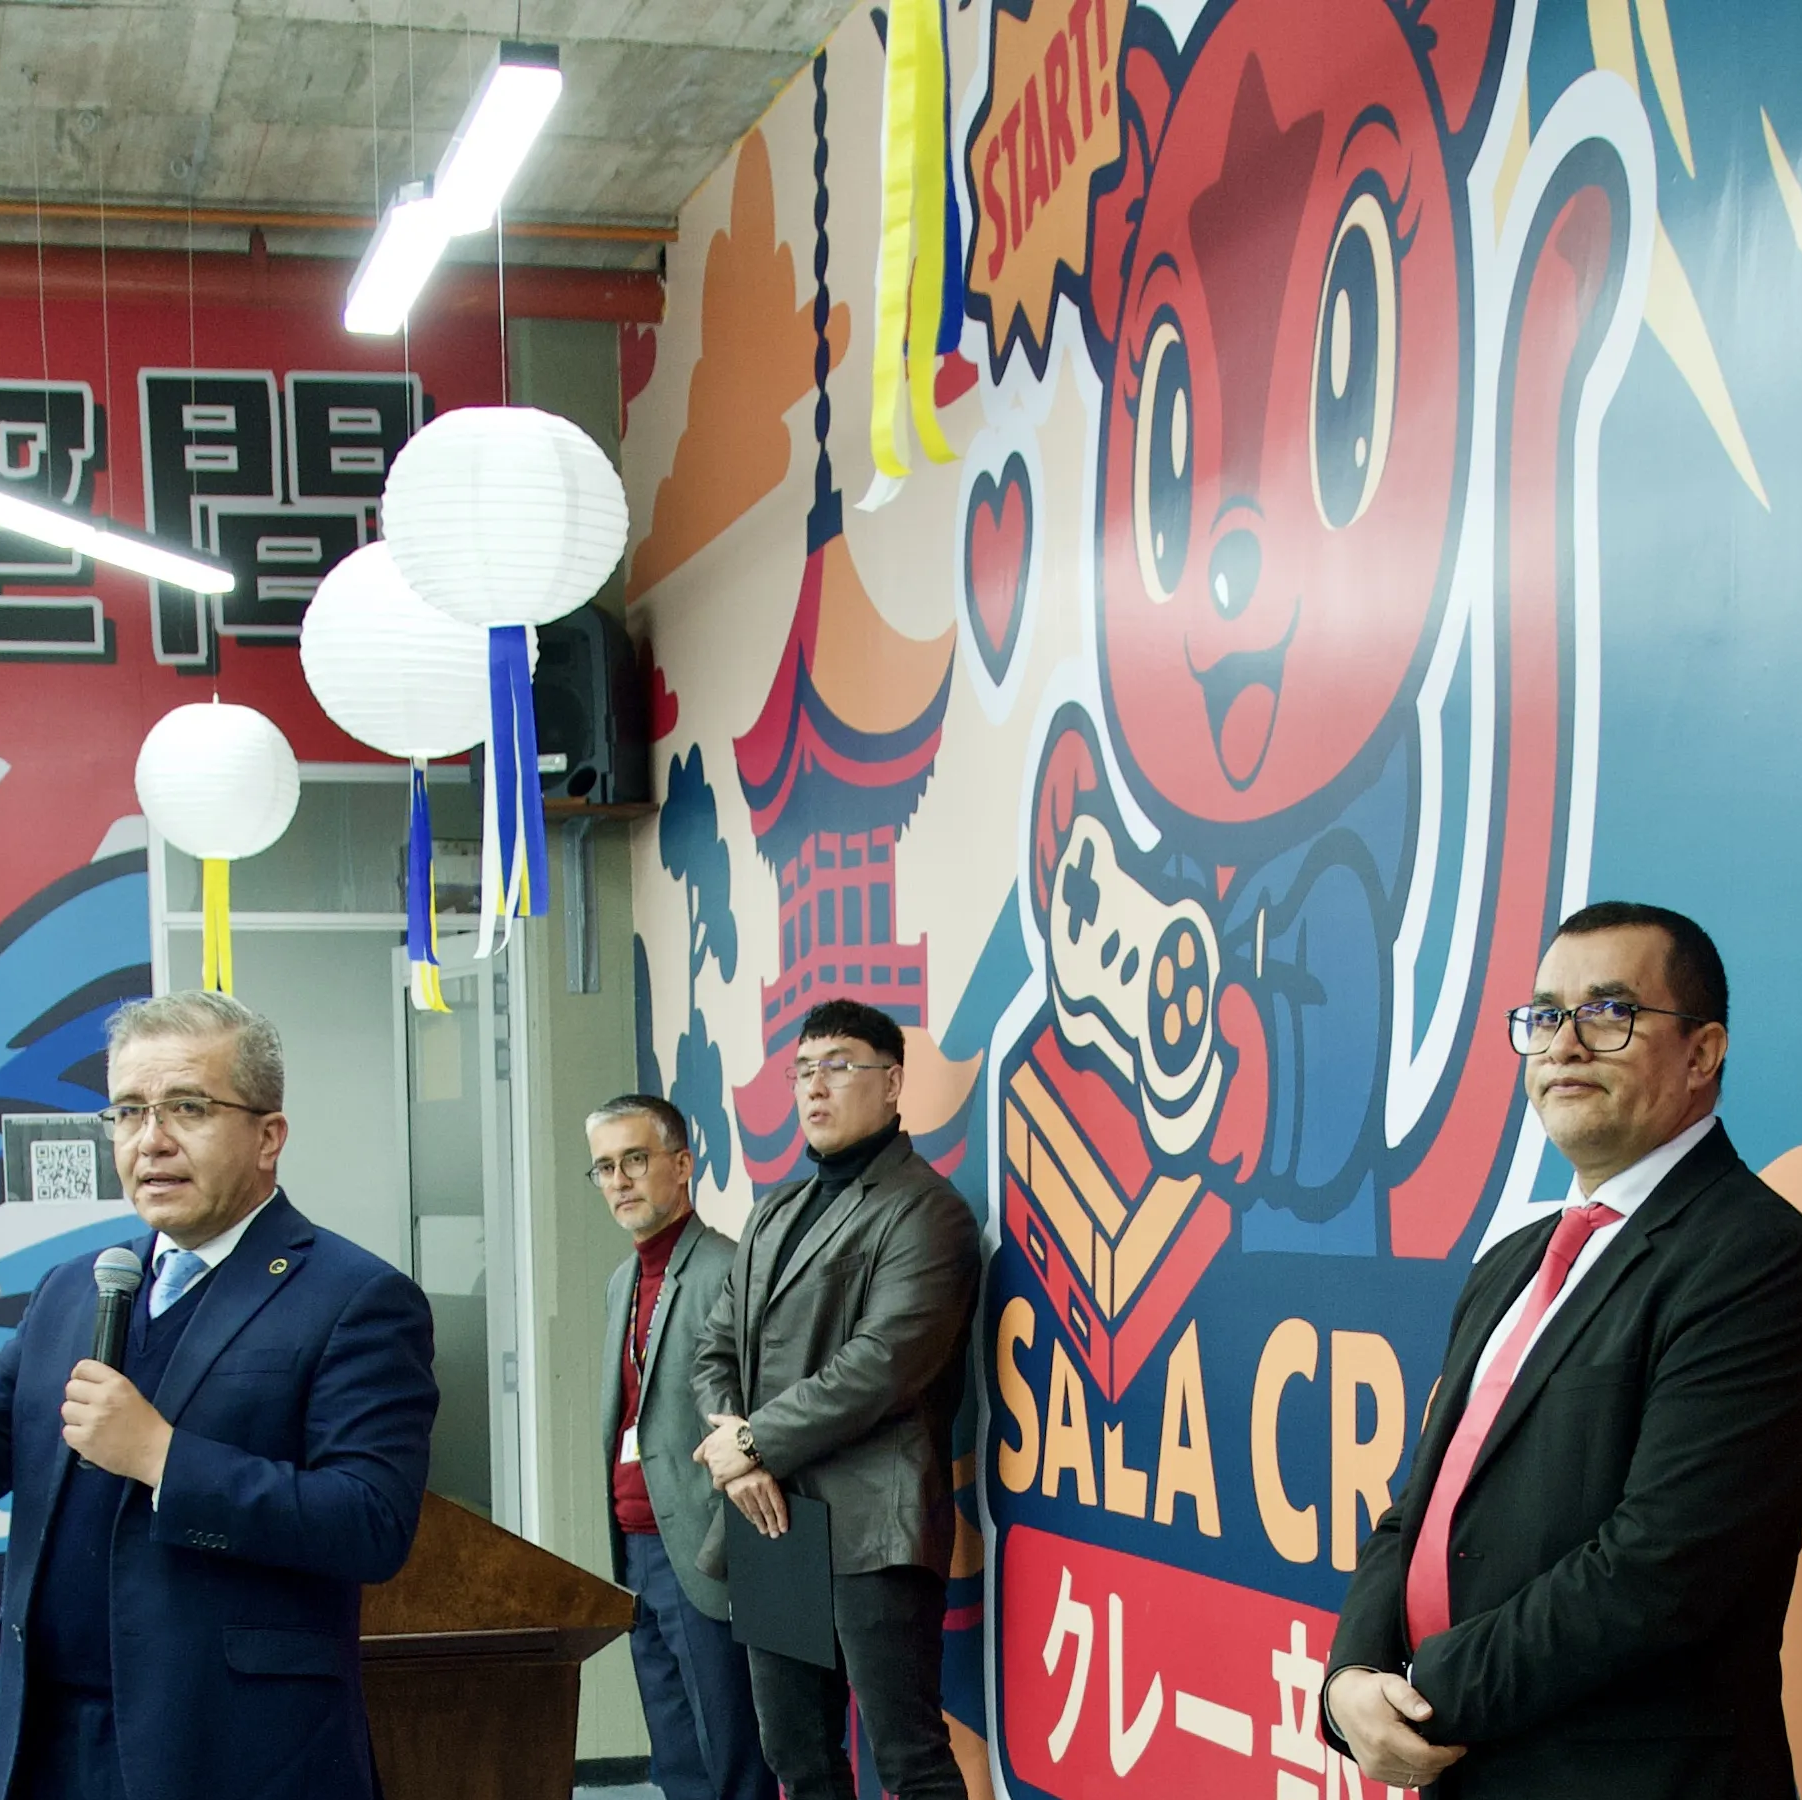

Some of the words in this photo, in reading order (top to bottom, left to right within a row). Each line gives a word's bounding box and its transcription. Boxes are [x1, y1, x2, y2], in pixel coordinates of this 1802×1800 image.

[983, 0, 1112, 281] START!
[998, 1296, 1222, 1538] SALA
[1250, 1317, 1443, 1572] CR
